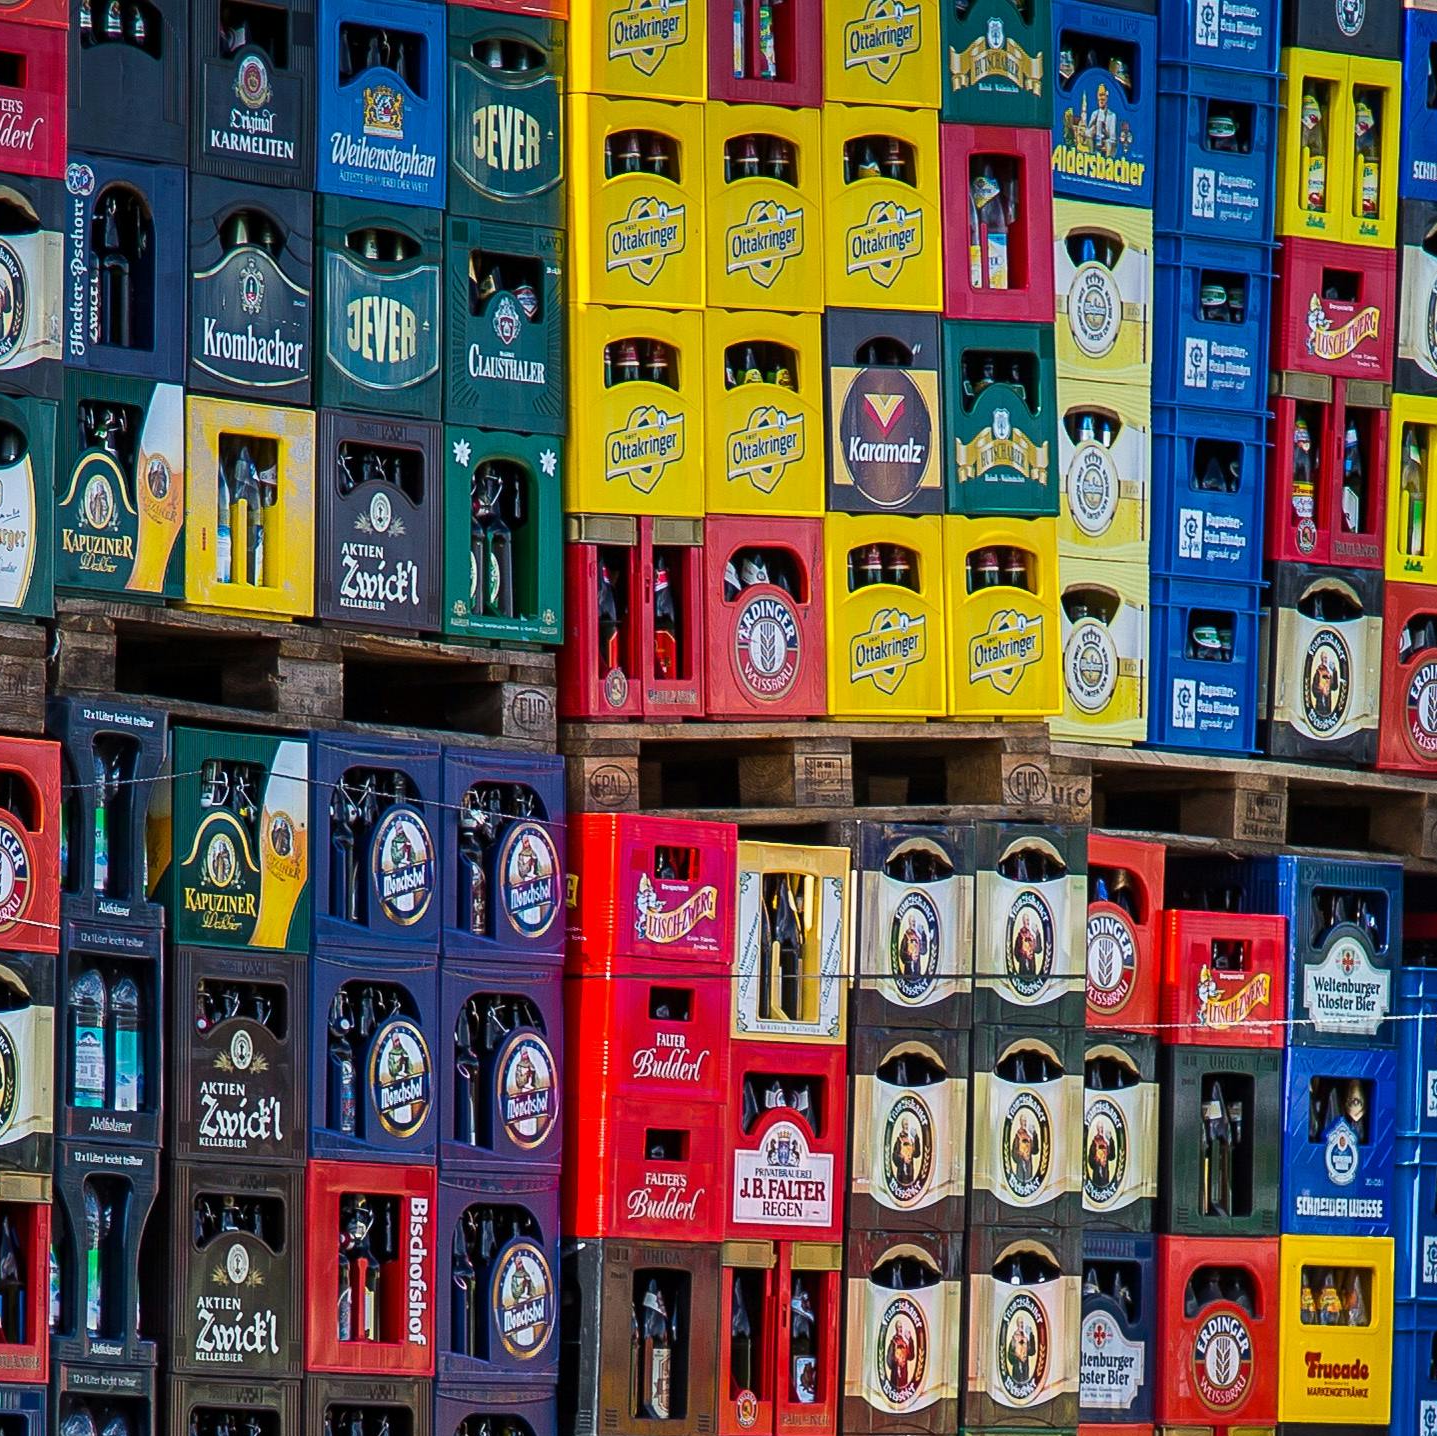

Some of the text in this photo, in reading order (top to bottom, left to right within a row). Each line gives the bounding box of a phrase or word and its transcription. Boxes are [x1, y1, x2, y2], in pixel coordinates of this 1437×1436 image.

[210, 129, 295, 160] KARMELITEN
[472, 105, 542, 172] JEVER
[330, 132, 436, 179] Weihenstephan
[1052, 145, 1145, 189] Aldersbacher
[611, 221, 679, 253] Ottakringer
[852, 224, 916, 257] Ottakringer
[67, 198, 85, 357] Hacker-Pschorr
[202, 317, 304, 371] Krombacher
[347, 296, 417, 362] JEVER
[467, 343, 545, 386] CLAUSTHALER
[610, 430, 678, 462] Ottakringer
[849, 438, 925, 466] Karamalz
[340, 541, 384, 560] AKTIEN
[340, 555, 419, 606] Zwick'l
[338, 597, 386, 614] KELLERBIER
[183, 887, 256, 917] KAPUZINER
[1313, 976, 1381, 999] Weltenburger
[1317, 993, 1376, 1012] Kloster Bier
[656, 1032, 685, 1048] FALTER
[632, 1047, 709, 1082] Budderl
[200, 1081, 246, 1097] AKTIEN
[200, 1096, 283, 1141] Zwick'l
[199, 1137, 248, 1150] KELLERBIER
[754, 1167, 812, 1179] PRIVATBRAUEREI
[767, 1178, 826, 1202] FALTER
[762, 1200, 804, 1218] REGEN
[410, 1204, 426, 1345] Bischofshof
[1194, 1312, 1251, 1357] ERDINGER
[1305, 1352, 1369, 1382] Frucade
[1306, 1386, 1369, 1399] MARKENGETRÄNKE
